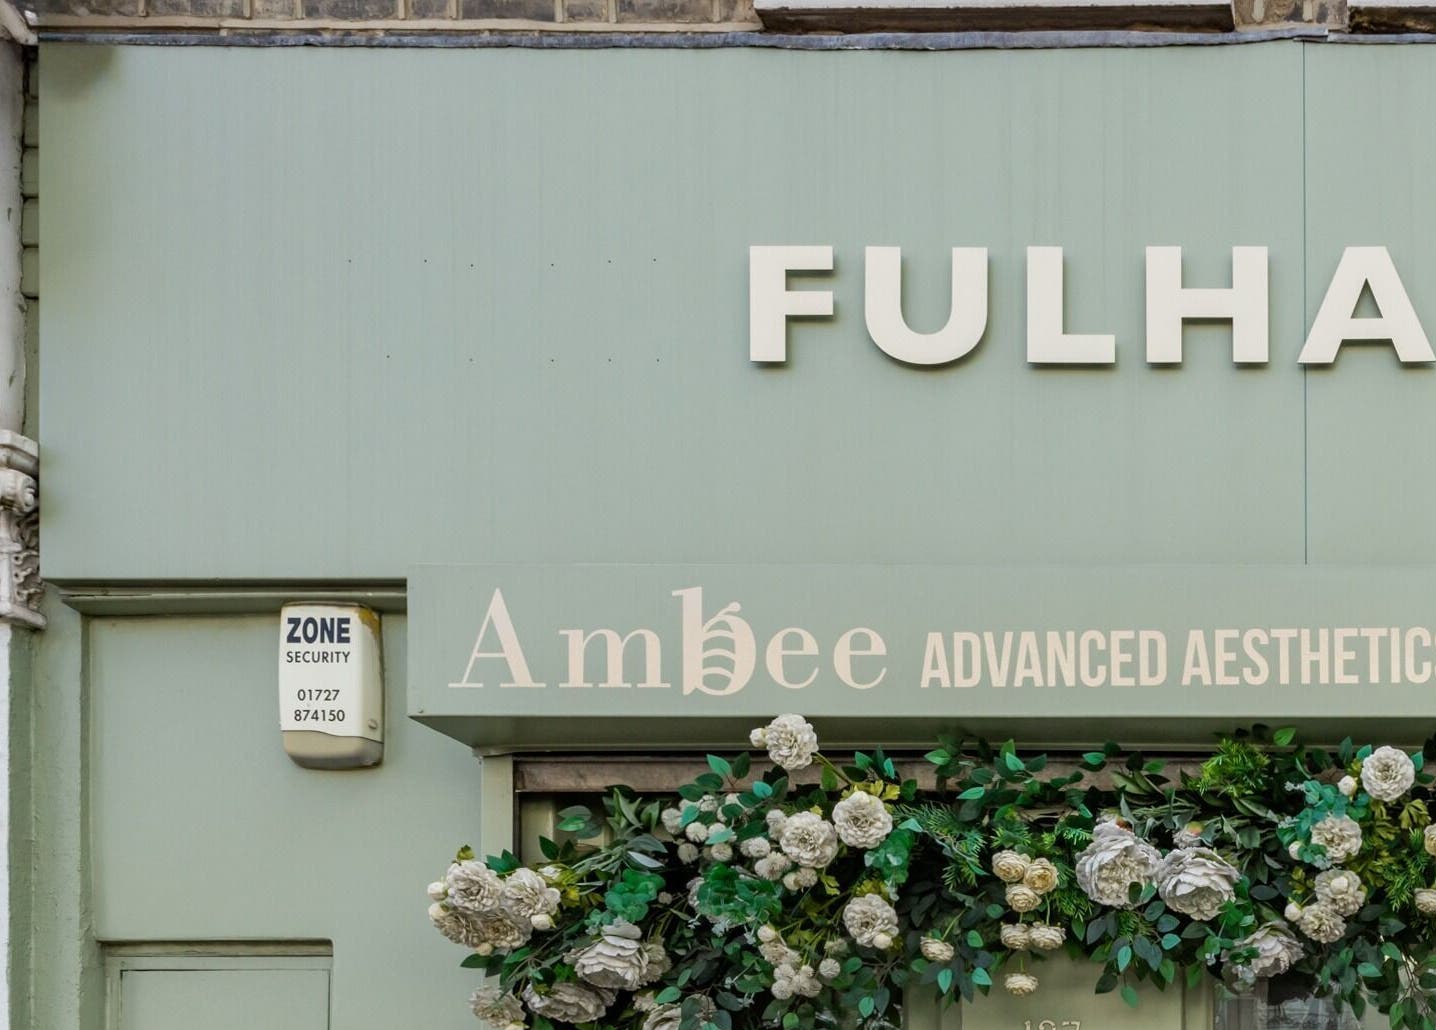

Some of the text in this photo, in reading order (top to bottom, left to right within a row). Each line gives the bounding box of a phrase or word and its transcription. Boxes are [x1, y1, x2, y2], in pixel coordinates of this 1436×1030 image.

[286, 617, 351, 644] ZONE
[448, 586, 888, 696] Ambee
[286, 651, 351, 664] SECURITY
[921, 630, 1169, 688] ADVANCED
[297, 689, 340, 701] 01727
[294, 709, 345, 722] 874150
